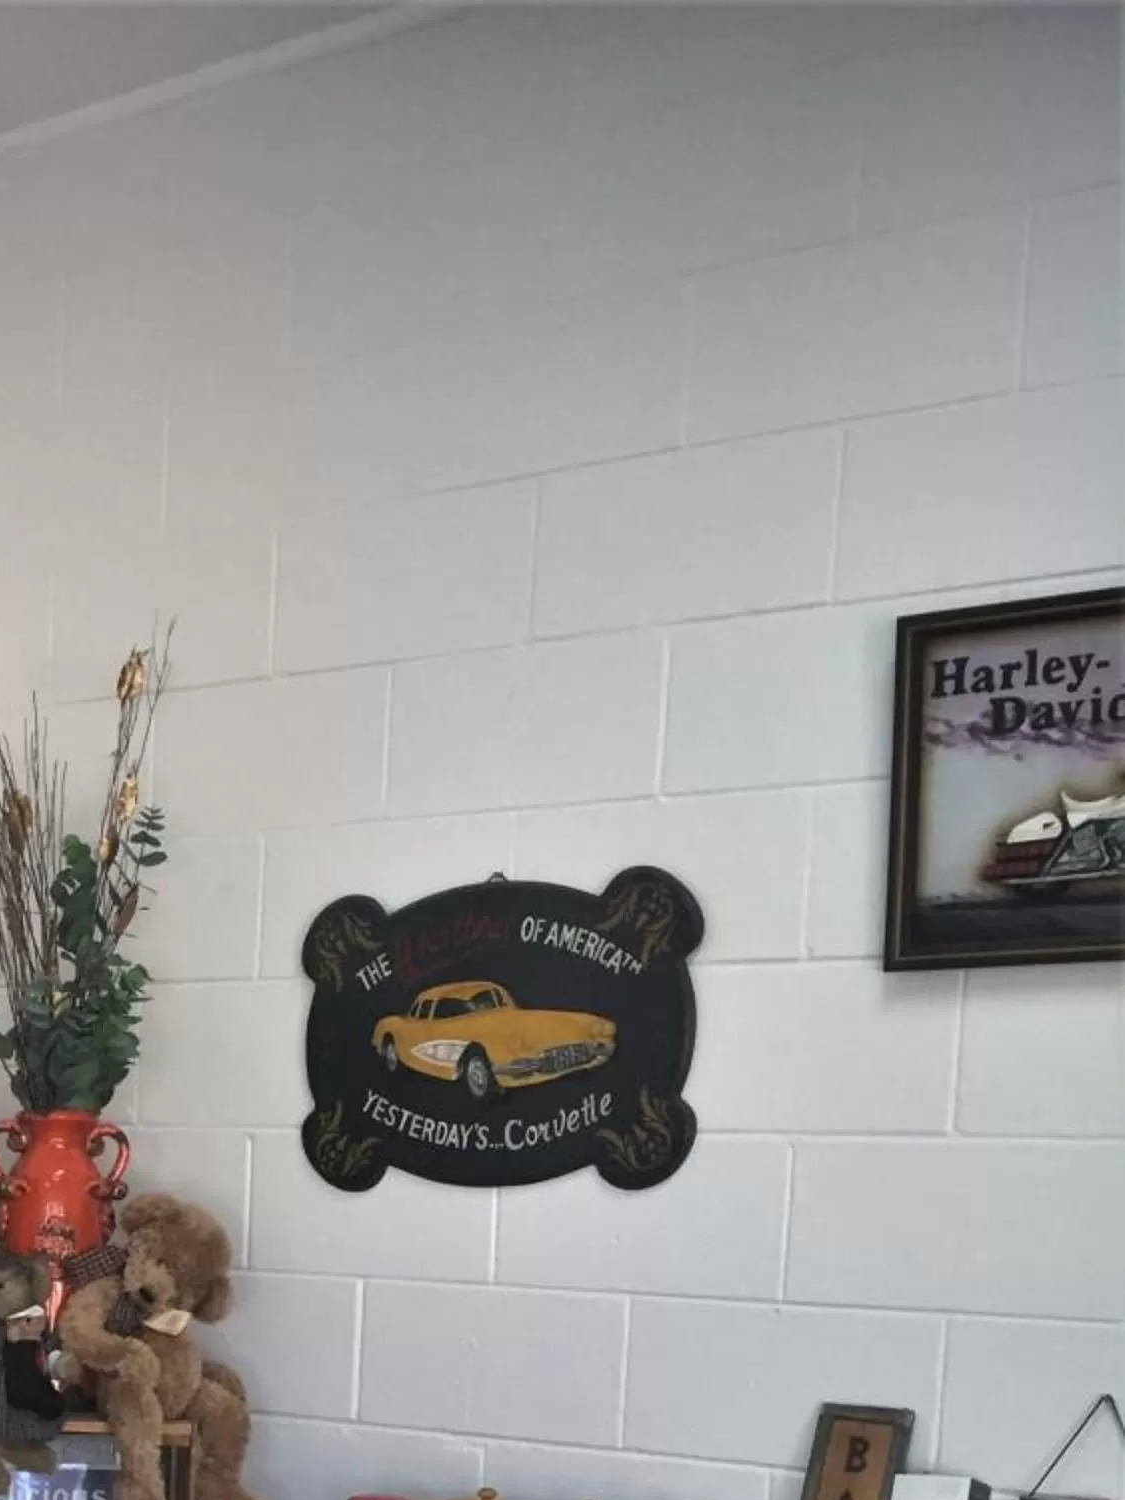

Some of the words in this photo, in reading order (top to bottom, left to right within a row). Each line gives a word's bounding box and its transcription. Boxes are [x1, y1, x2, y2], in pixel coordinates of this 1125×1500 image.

[931, 647, 1111, 700] Harley-
[355, 951, 394, 992] THE
[520, 915, 547, 943] OF
